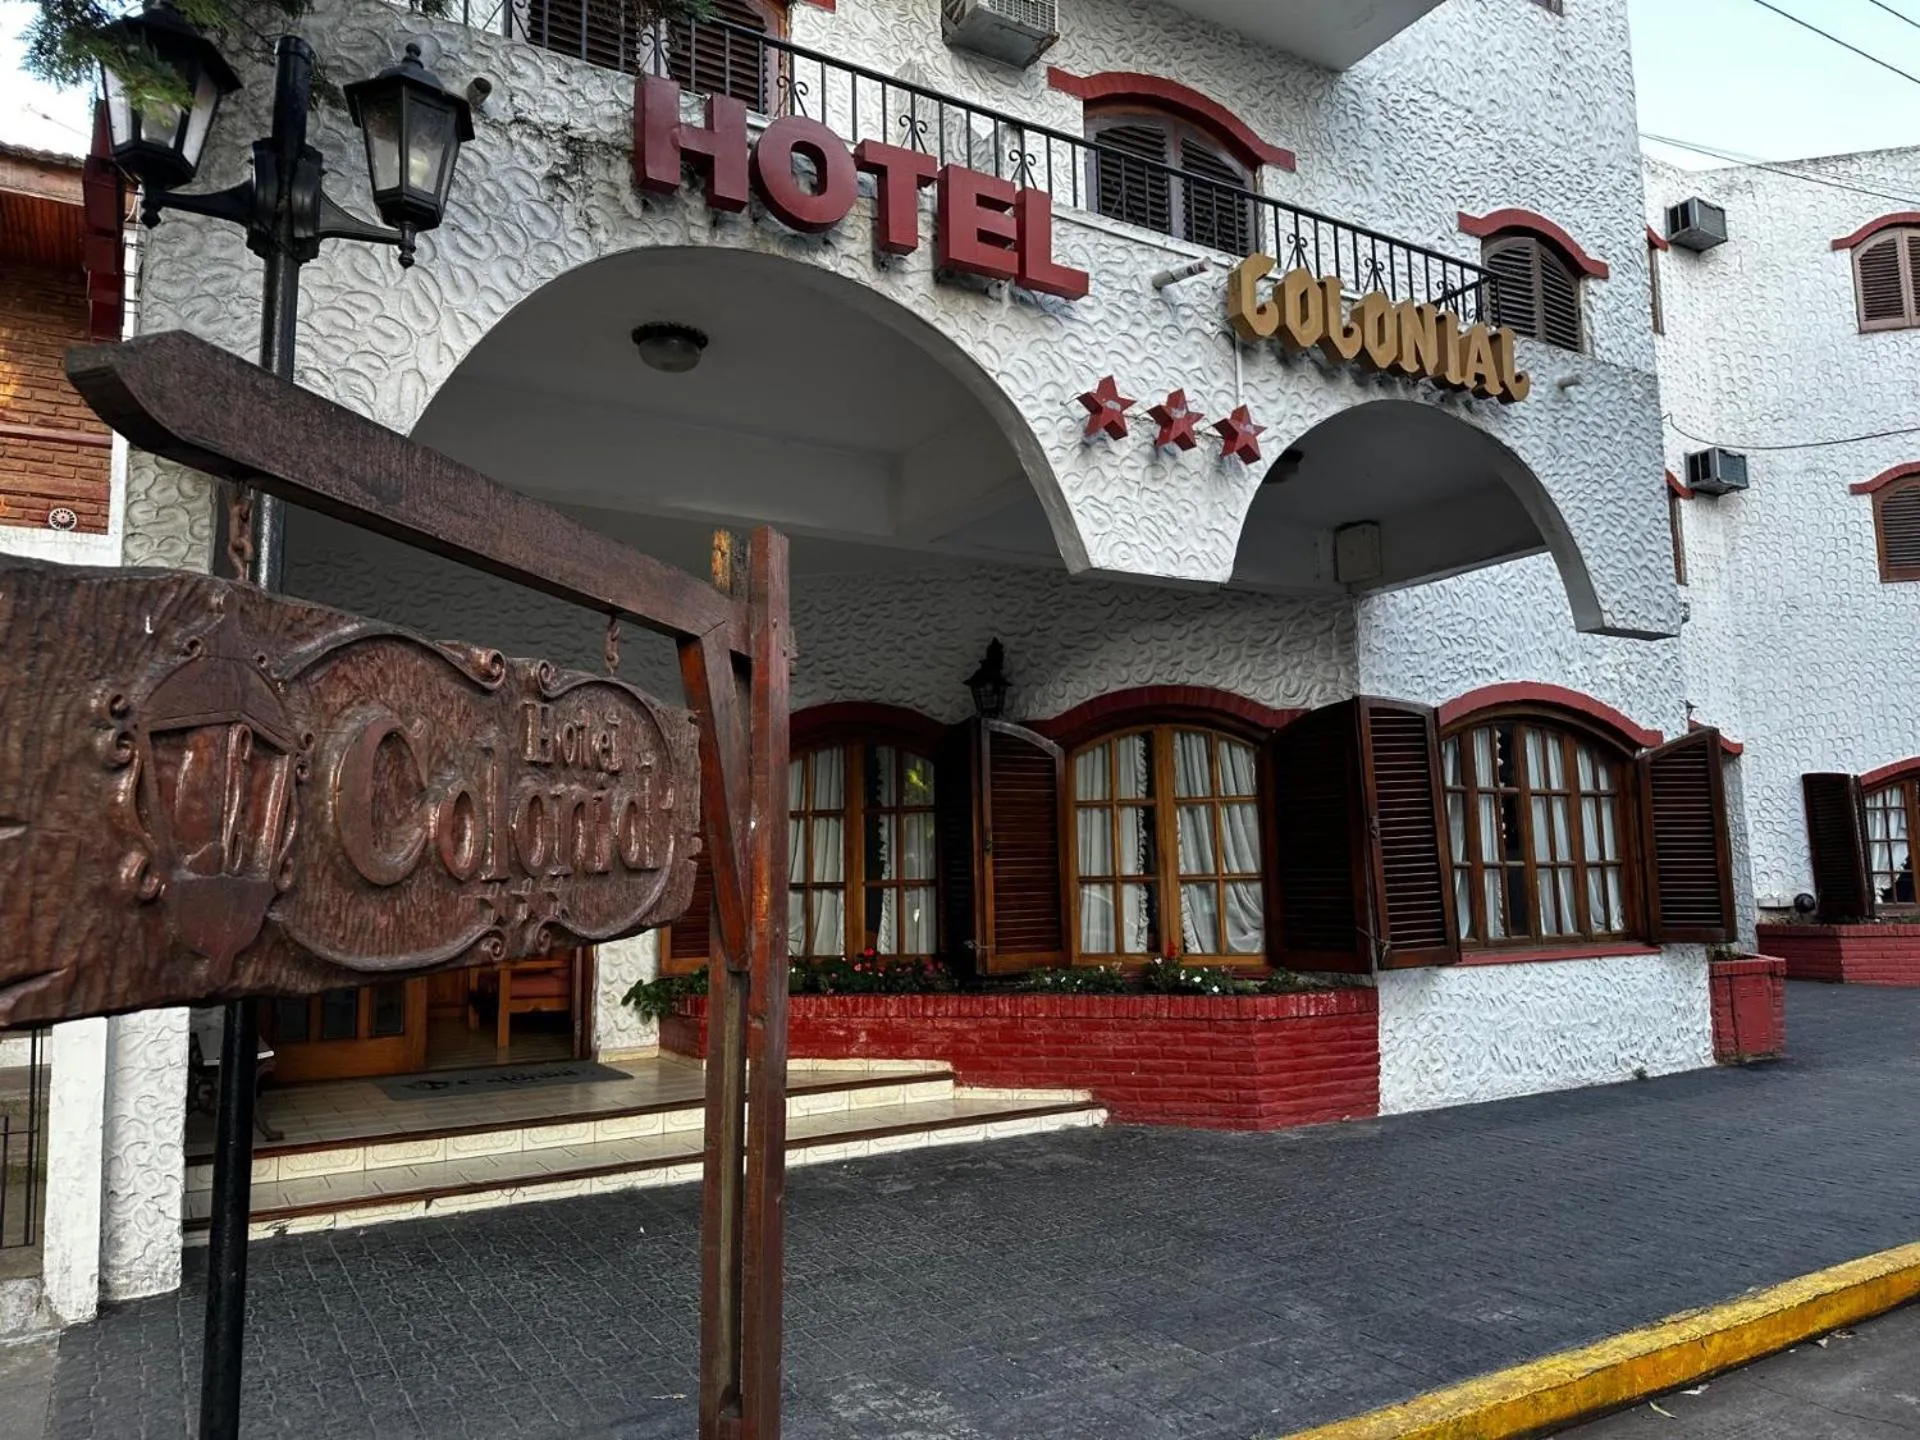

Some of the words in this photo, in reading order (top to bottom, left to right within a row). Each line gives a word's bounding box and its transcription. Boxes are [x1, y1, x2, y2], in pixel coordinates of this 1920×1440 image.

[634, 74, 1089, 300] HOTEL
[1227, 253, 1529, 401] COLONIAL
[335, 704, 662, 886] Colonial
[521, 701, 623, 773] Hotel
